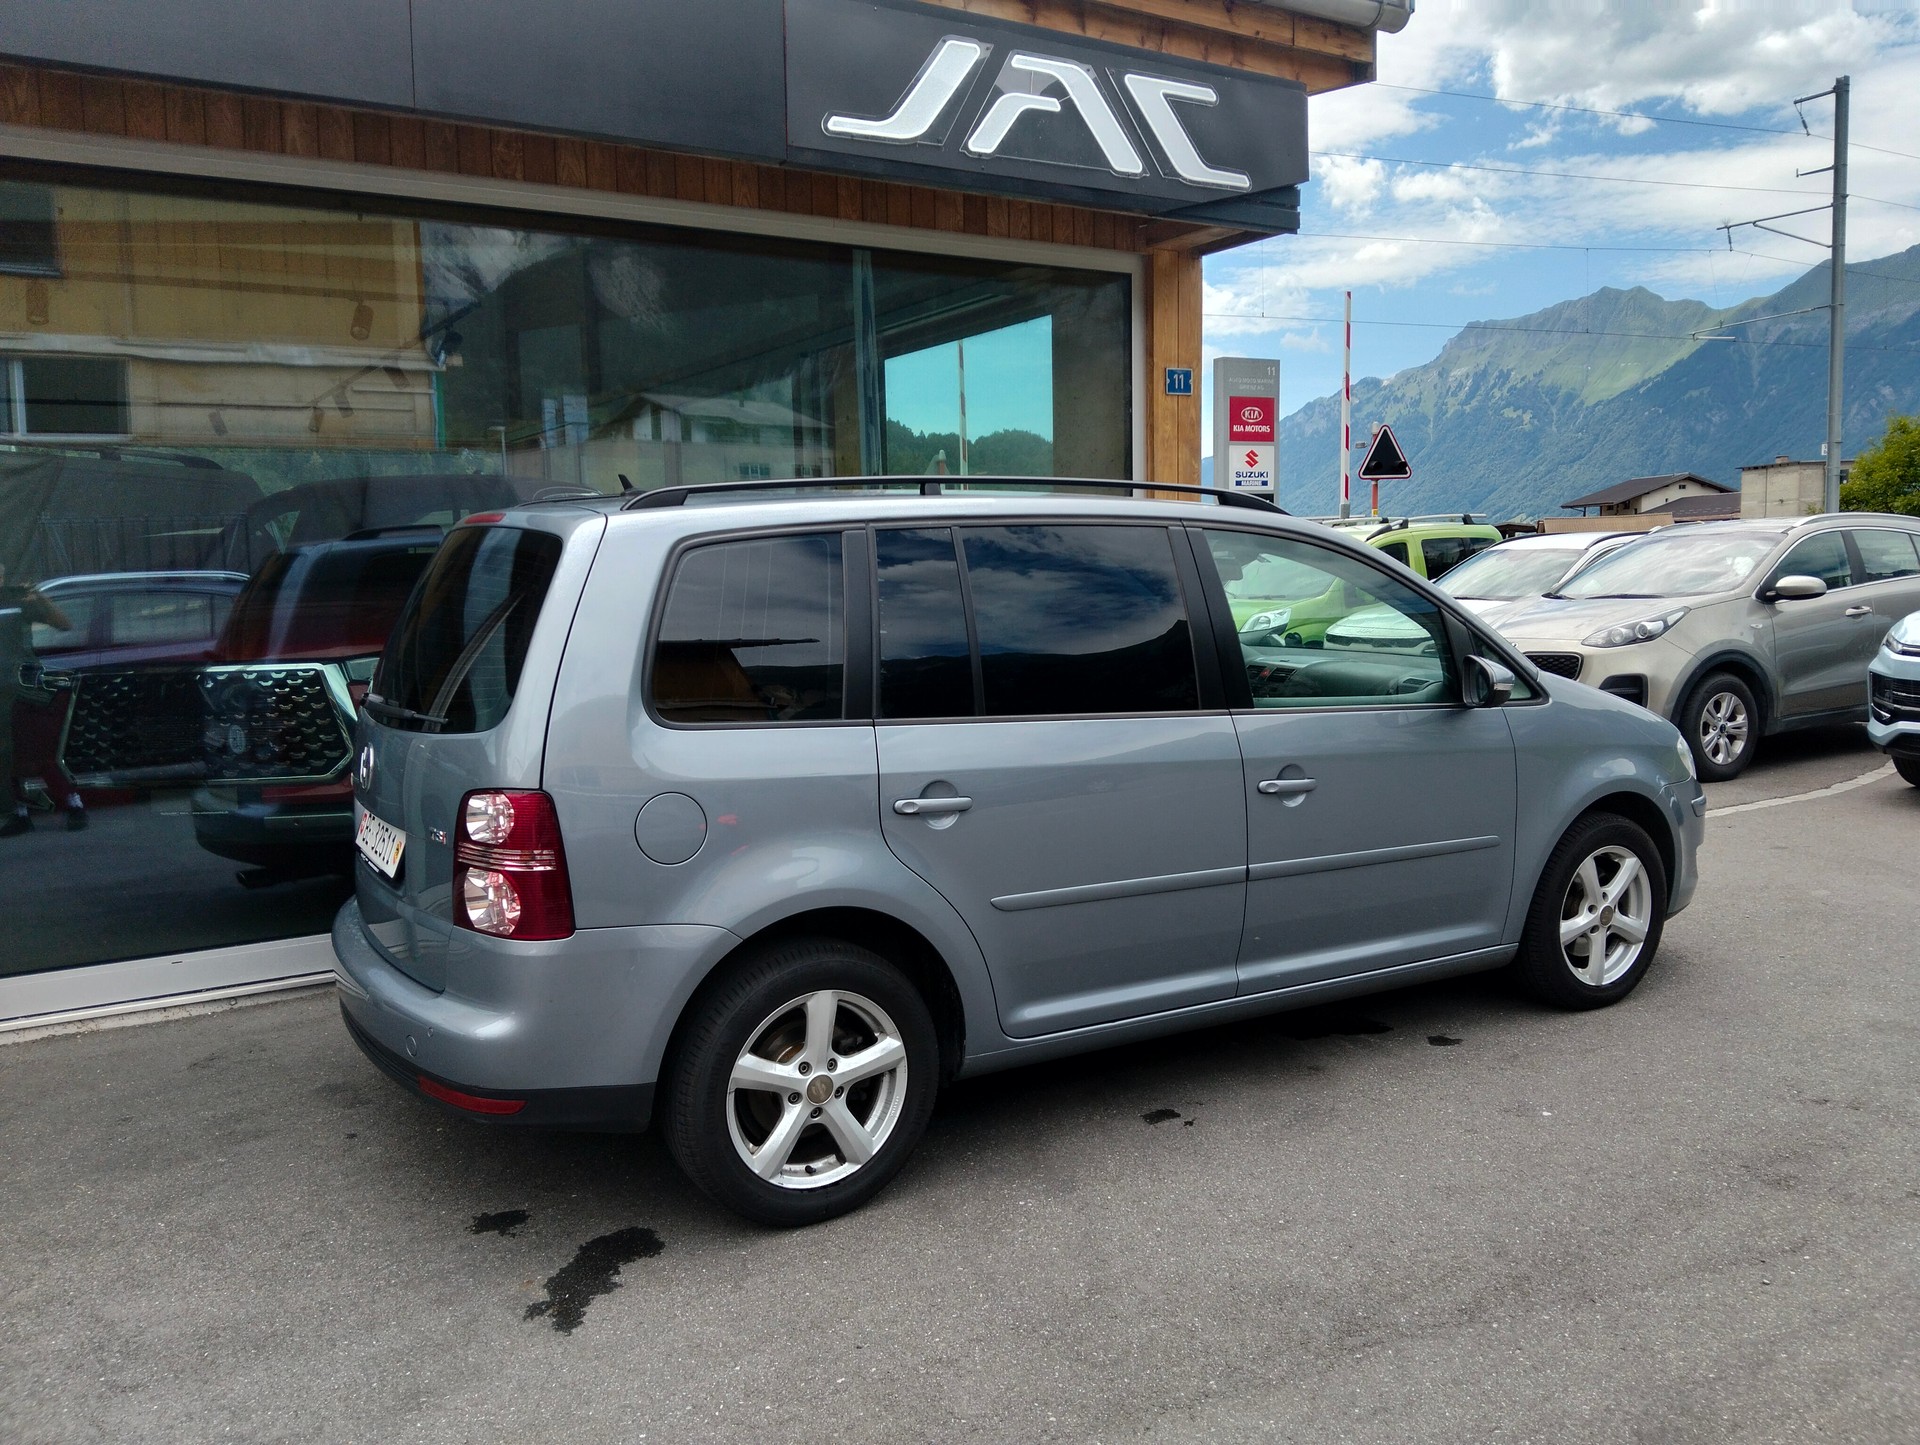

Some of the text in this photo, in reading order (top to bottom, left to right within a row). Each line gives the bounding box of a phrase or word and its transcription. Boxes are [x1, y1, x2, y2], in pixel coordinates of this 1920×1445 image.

[826, 38, 1252, 190] JAC
[1267, 366, 1276, 376] 11
[1173, 373, 1184, 390] 11
[1233, 424, 1271, 433] KIA MOTORS
[1235, 471, 1269, 479] SUZUKI
